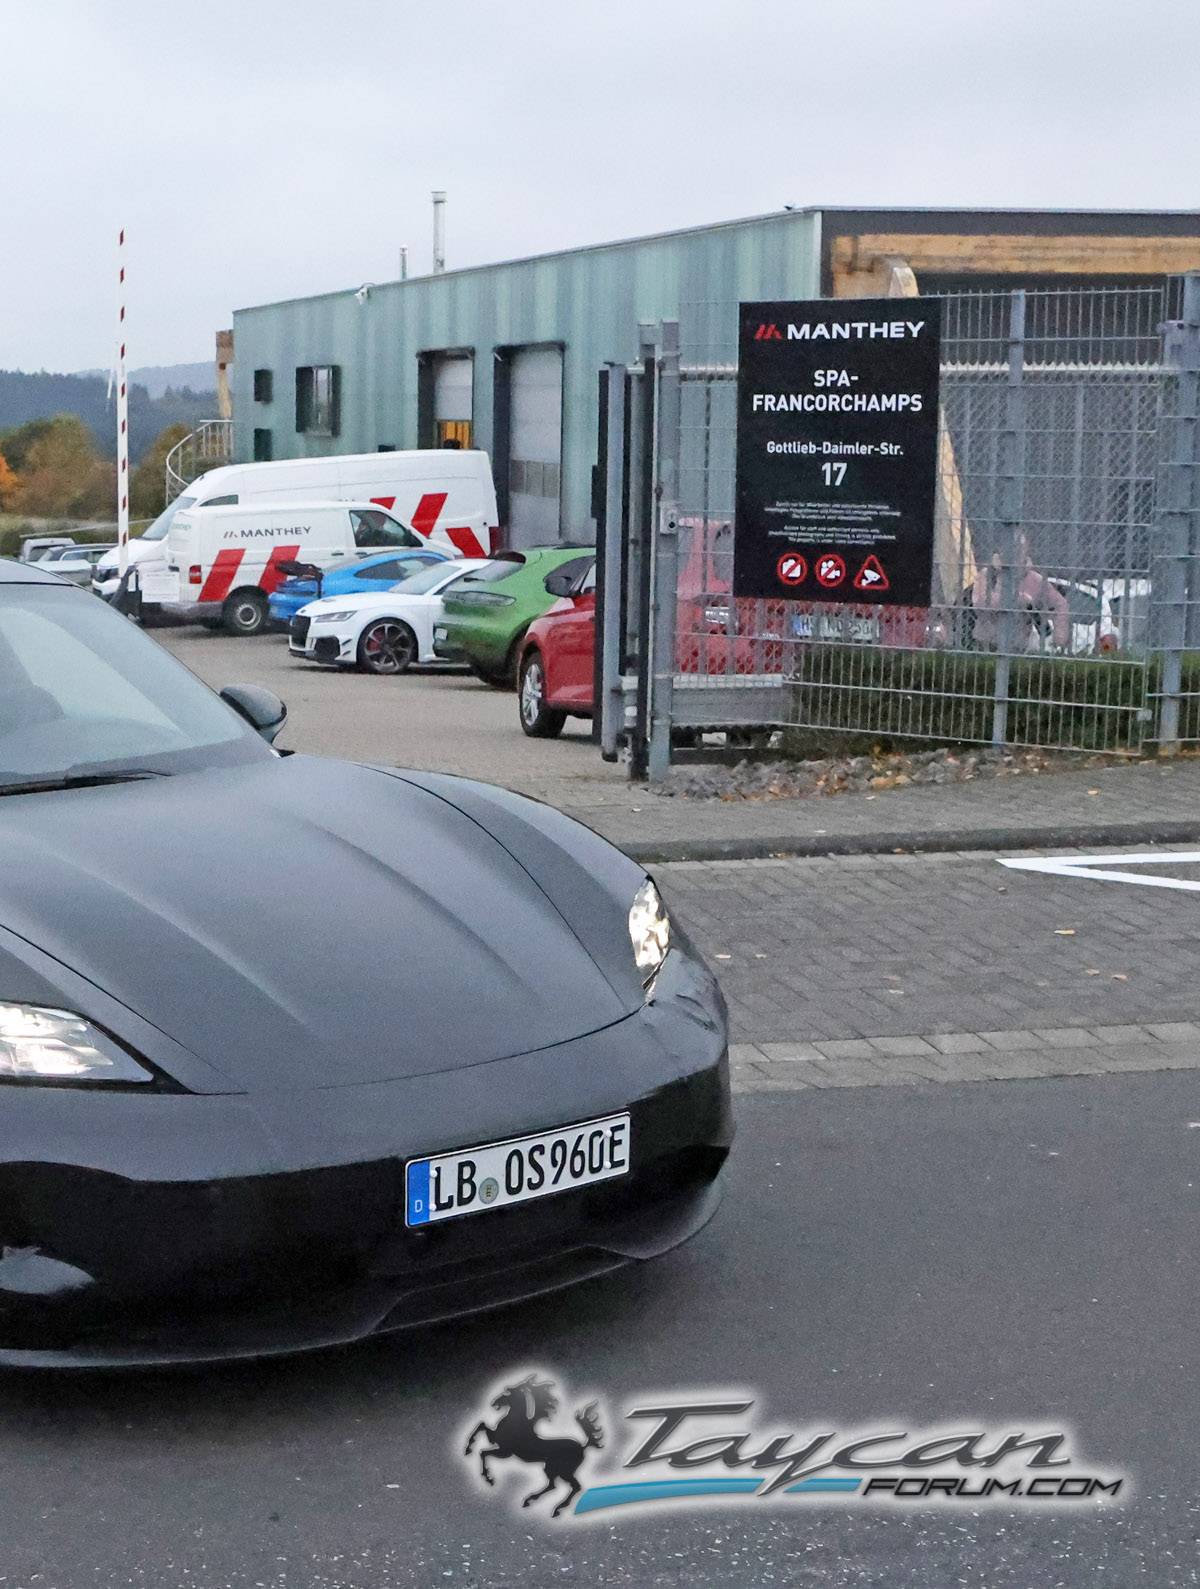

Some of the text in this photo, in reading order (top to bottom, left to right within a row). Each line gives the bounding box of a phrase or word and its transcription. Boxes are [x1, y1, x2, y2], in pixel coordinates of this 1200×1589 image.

[787, 321, 925, 340] MANTHEY
[813, 369, 859, 387] SPA-
[752, 394, 923, 412] FRANCORCHAMPS
[766, 441, 904, 456] Gottlieb-Daimler-Str.
[821, 462, 848, 487] 17
[240, 526, 312, 538] MANTHEY
[414, 1199, 422, 1213] D
[434, 1160, 477, 1211] LB
